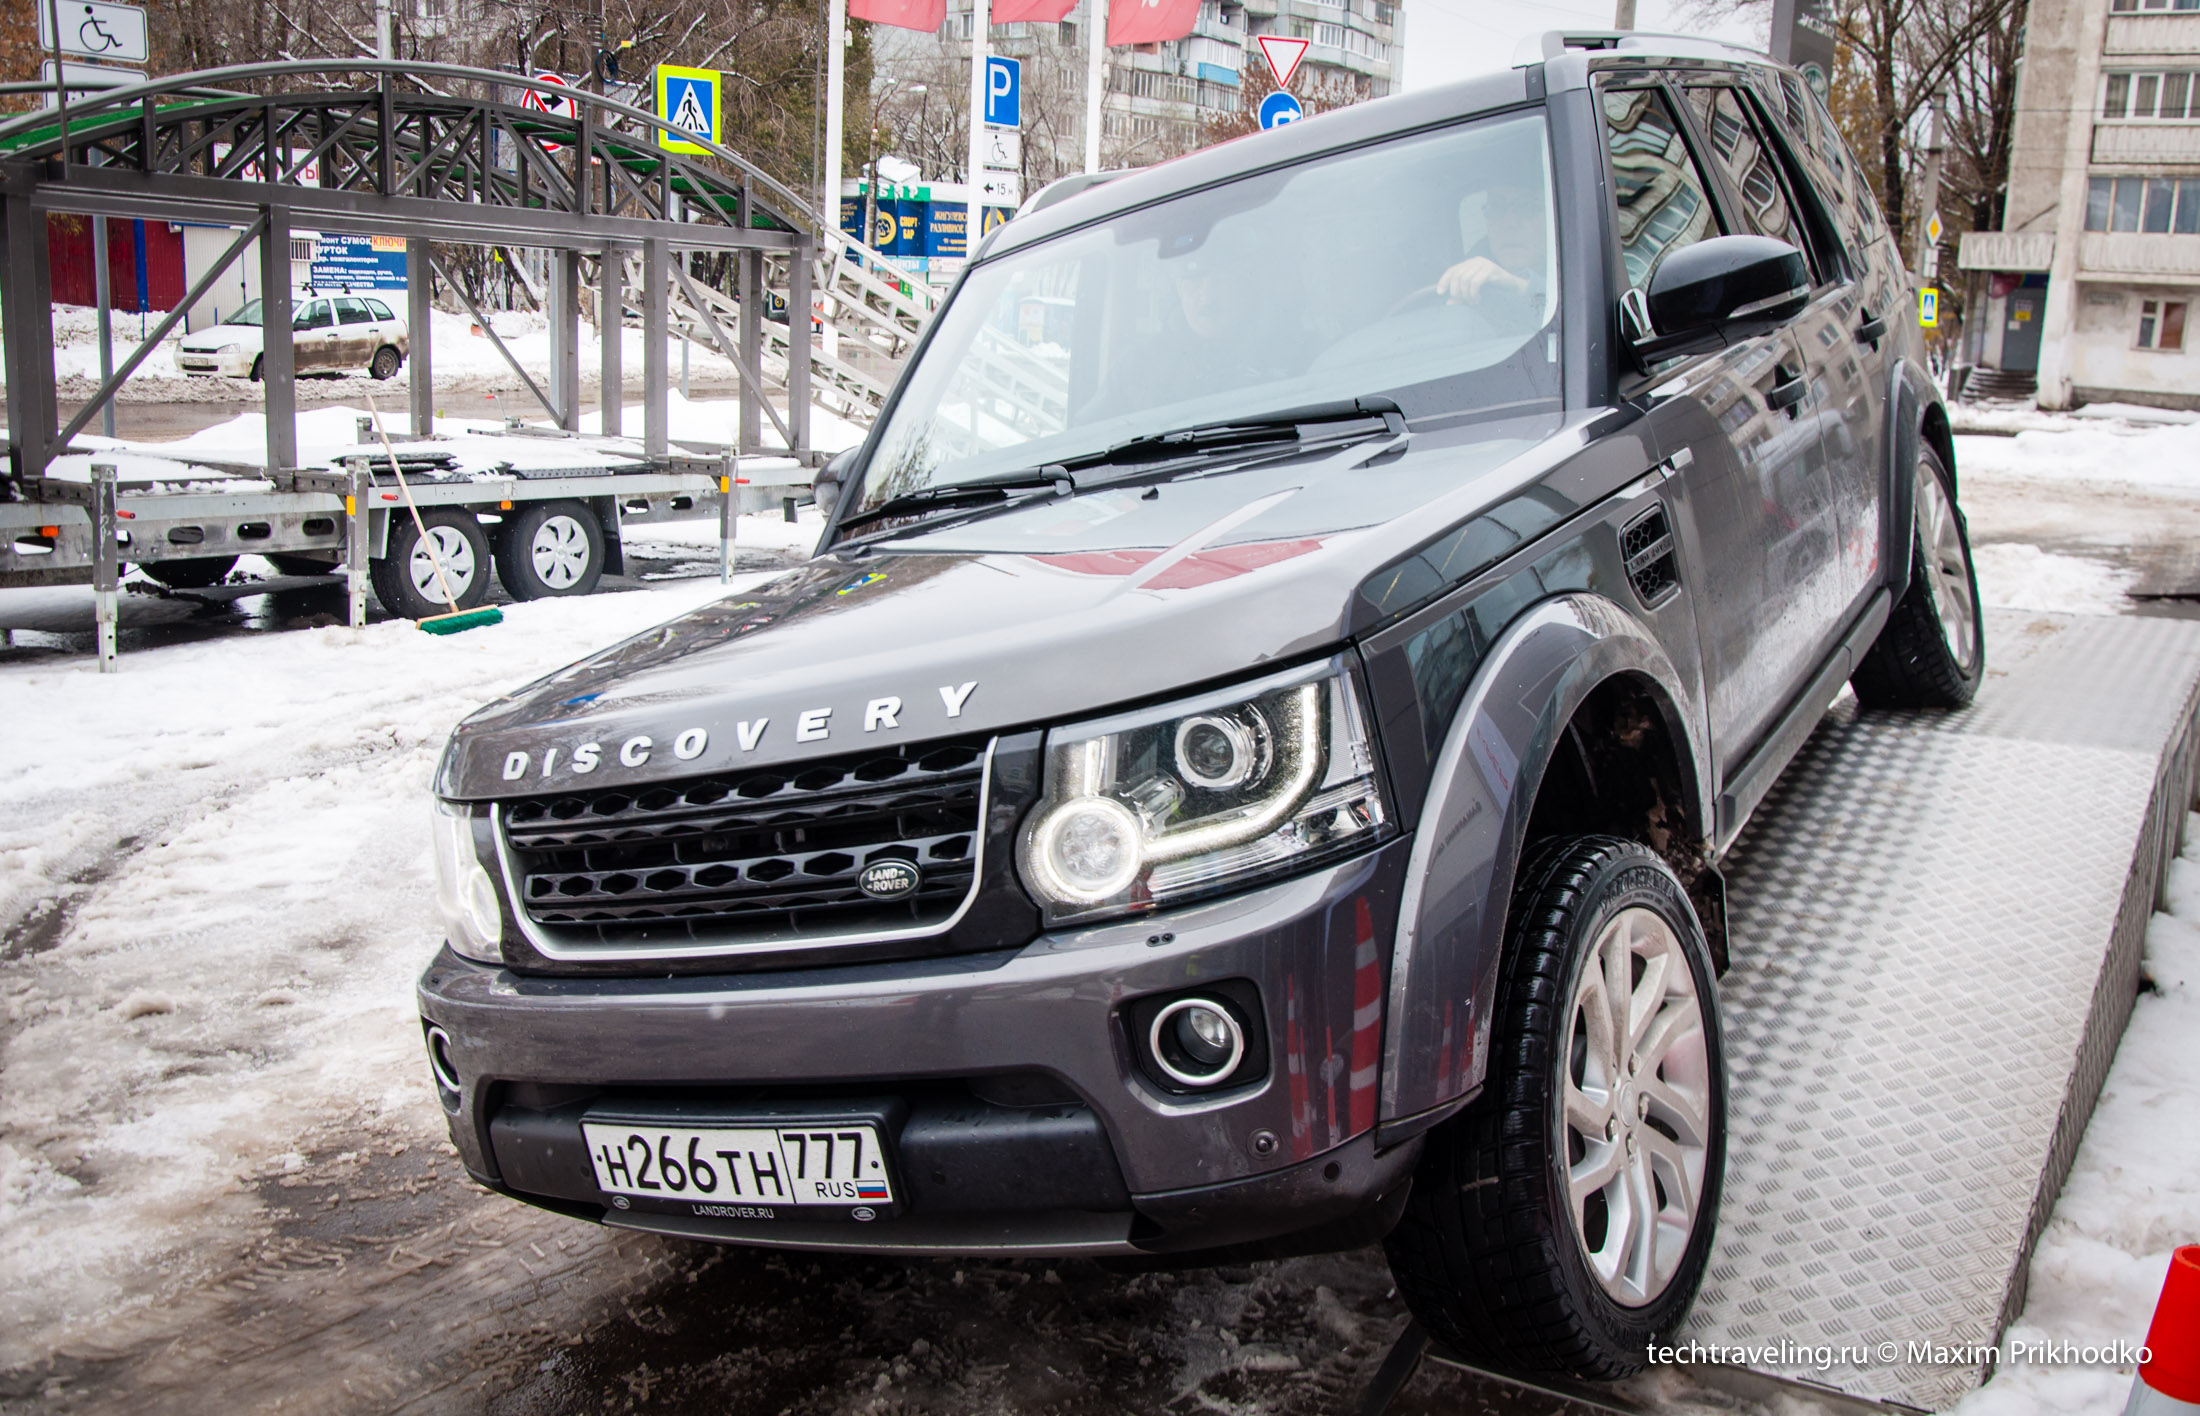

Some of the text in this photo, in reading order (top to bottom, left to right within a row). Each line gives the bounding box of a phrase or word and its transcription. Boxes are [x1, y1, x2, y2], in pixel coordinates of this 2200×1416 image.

[989, 63, 1011, 117] P
[997, 182, 1006, 196] 15
[341, 236, 372, 246] СУМОК
[373, 236, 406, 248] КЛЮЧИ
[318, 245, 348, 255] УРТОК
[502, 681, 979, 782] DISCOVERY
[868, 867, 898, 882] LAND
[873, 877, 909, 892] ROVER
[782, 1132, 862, 1180] 777
[815, 1181, 856, 1198] RUS
[692, 1204, 775, 1220] LANDROVER.RU
